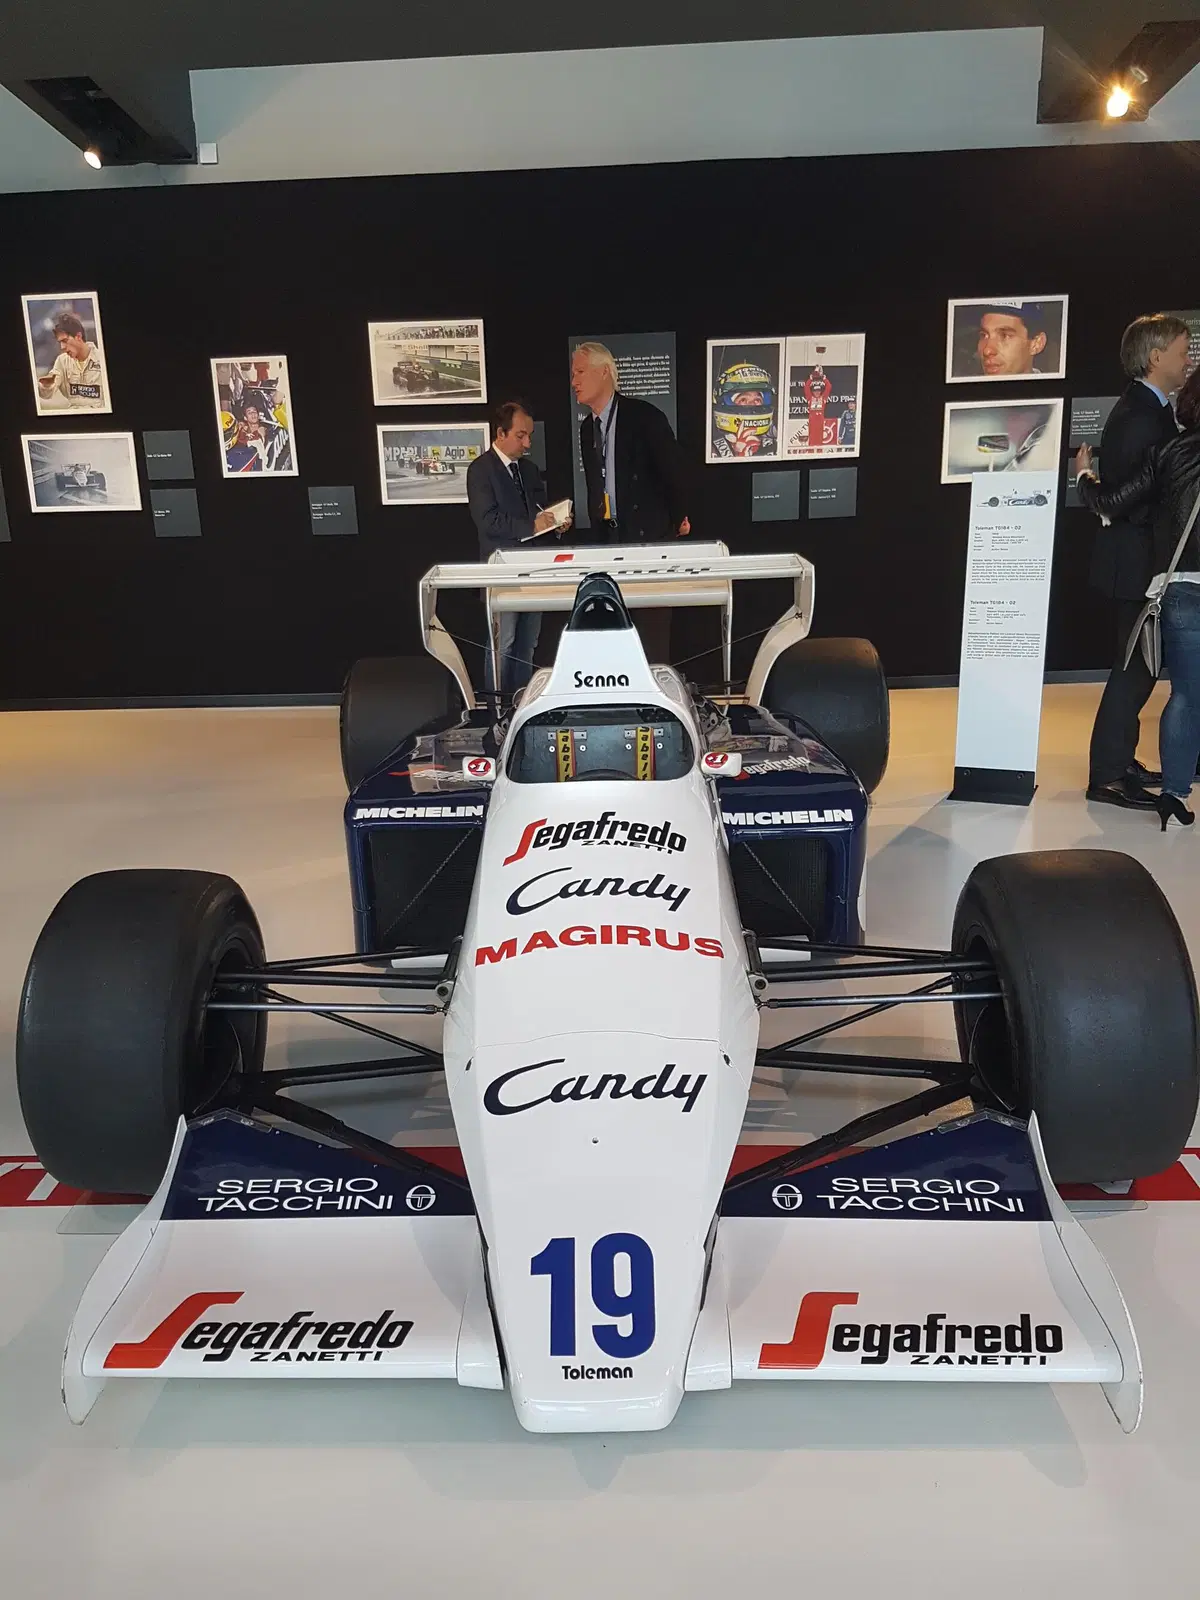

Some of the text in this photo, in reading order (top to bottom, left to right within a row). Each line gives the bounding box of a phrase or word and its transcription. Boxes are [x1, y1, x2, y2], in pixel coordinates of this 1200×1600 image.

[444, 446, 465, 459] Agip
[574, 670, 630, 688] Senna
[734, 755, 811, 780] egafredo
[353, 804, 485, 820] MICHELIN
[722, 809, 854, 826] MICHELIN
[502, 811, 688, 867] Segafredo
[581, 839, 674, 855] ZANETTI
[505, 866, 692, 916] Candy
[474, 924, 725, 967] MAGIRUS
[483, 1058, 708, 1116] Candy
[216, 1177, 379, 1195] SERGIO
[831, 1177, 1001, 1195] SERGIO
[197, 1194, 394, 1212] TACCHINI
[816, 1194, 1025, 1213] TACCHINI
[530, 1232, 656, 1359] 19
[103, 1291, 415, 1369] Segafredo
[757, 1291, 1064, 1370] Segafredo
[249, 1351, 384, 1362] ZANETTI
[909, 1354, 1048, 1366] ZANETTI
[561, 1365, 634, 1380] Toleman
